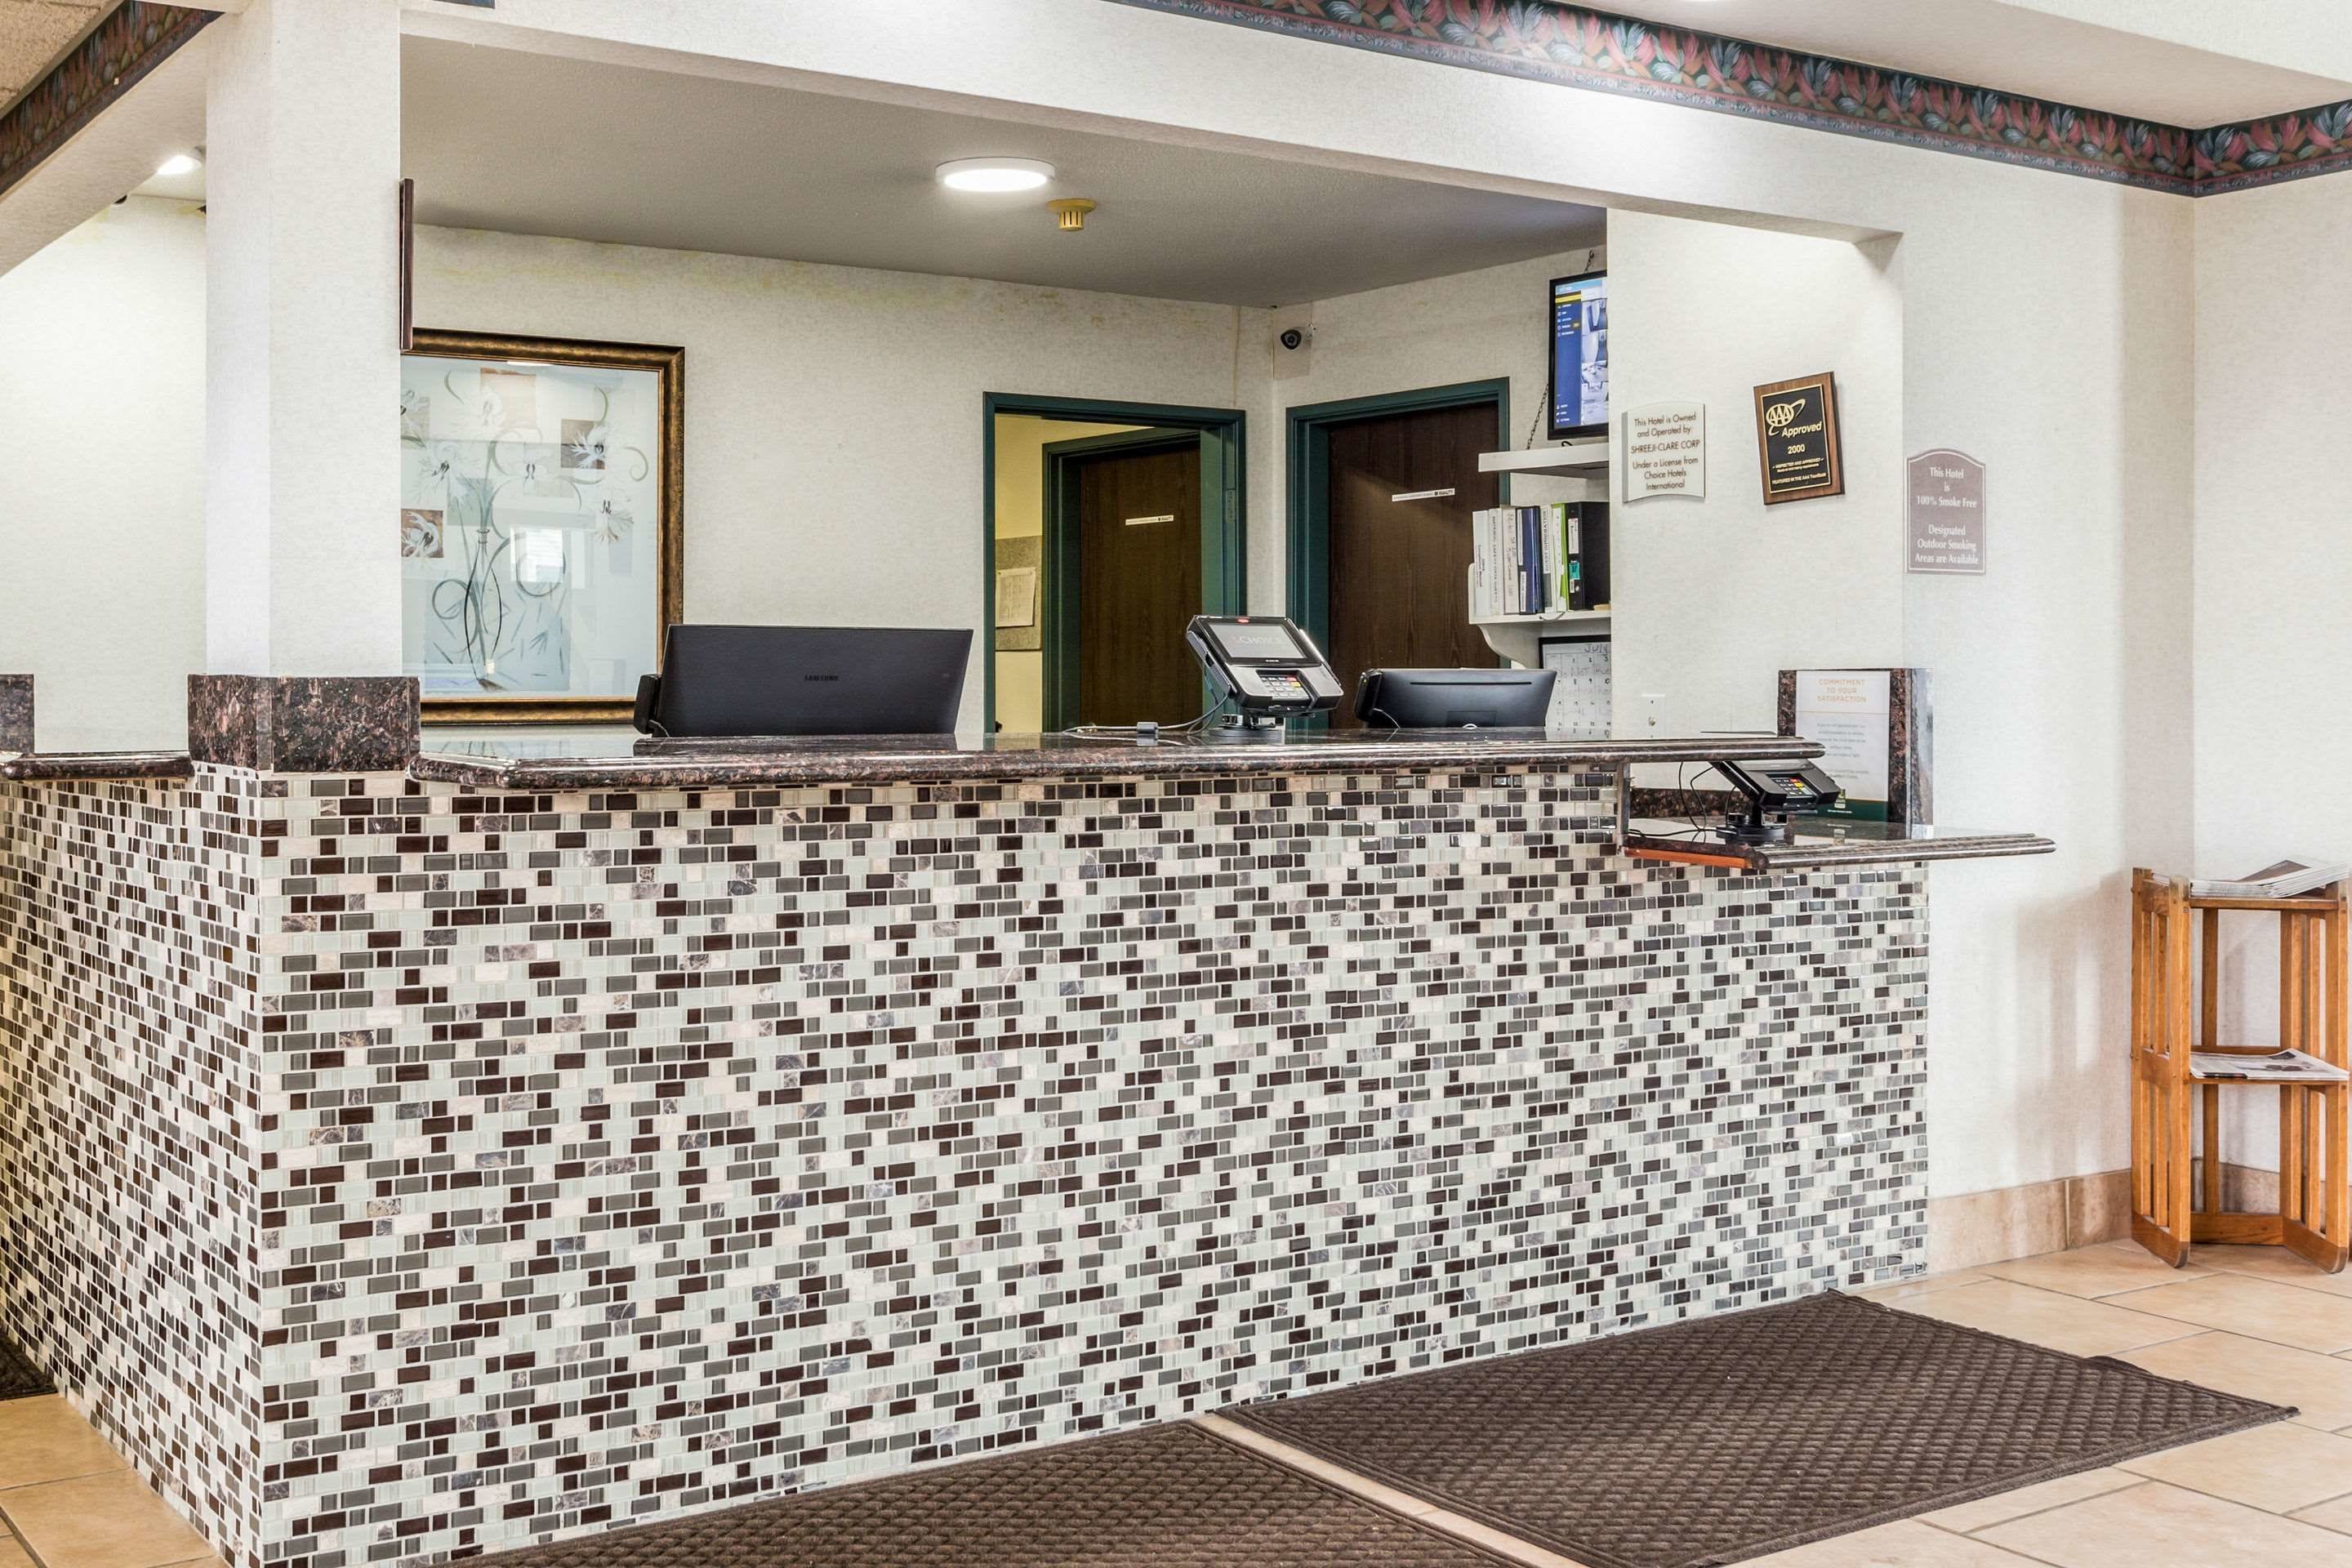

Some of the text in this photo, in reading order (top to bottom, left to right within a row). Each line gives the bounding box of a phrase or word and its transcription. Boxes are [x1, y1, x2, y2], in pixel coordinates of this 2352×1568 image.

[1648, 415, 1664, 425] Hotel
[1673, 412, 1696, 422] Owned
[1769, 405, 1791, 425] AAA
[1637, 429, 1649, 438] and
[1651, 425, 1682, 437] Operated
[1782, 421, 1822, 438] Approved
[1681, 439, 1700, 448] CORP
[1788, 444, 1806, 455] 2000
[1633, 460, 1651, 470] Under
[1659, 459, 1682, 467] License
[1683, 456, 1699, 465] from
[1644, 467, 1686, 479] Choice Hotels
[1930, 466, 1964, 479] This Hotel
[1646, 480, 1685, 490] International
[1944, 481, 1950, 492] is
[1917, 495, 1977, 508] 100% Smoke Free
[1928, 523, 1966, 537] Designated
[1917, 538, 1977, 553] Outdoor Smoking
[1915, 554, 1979, 564] Areas are Available
[1817, 694, 1868, 703] SATISFACTION
